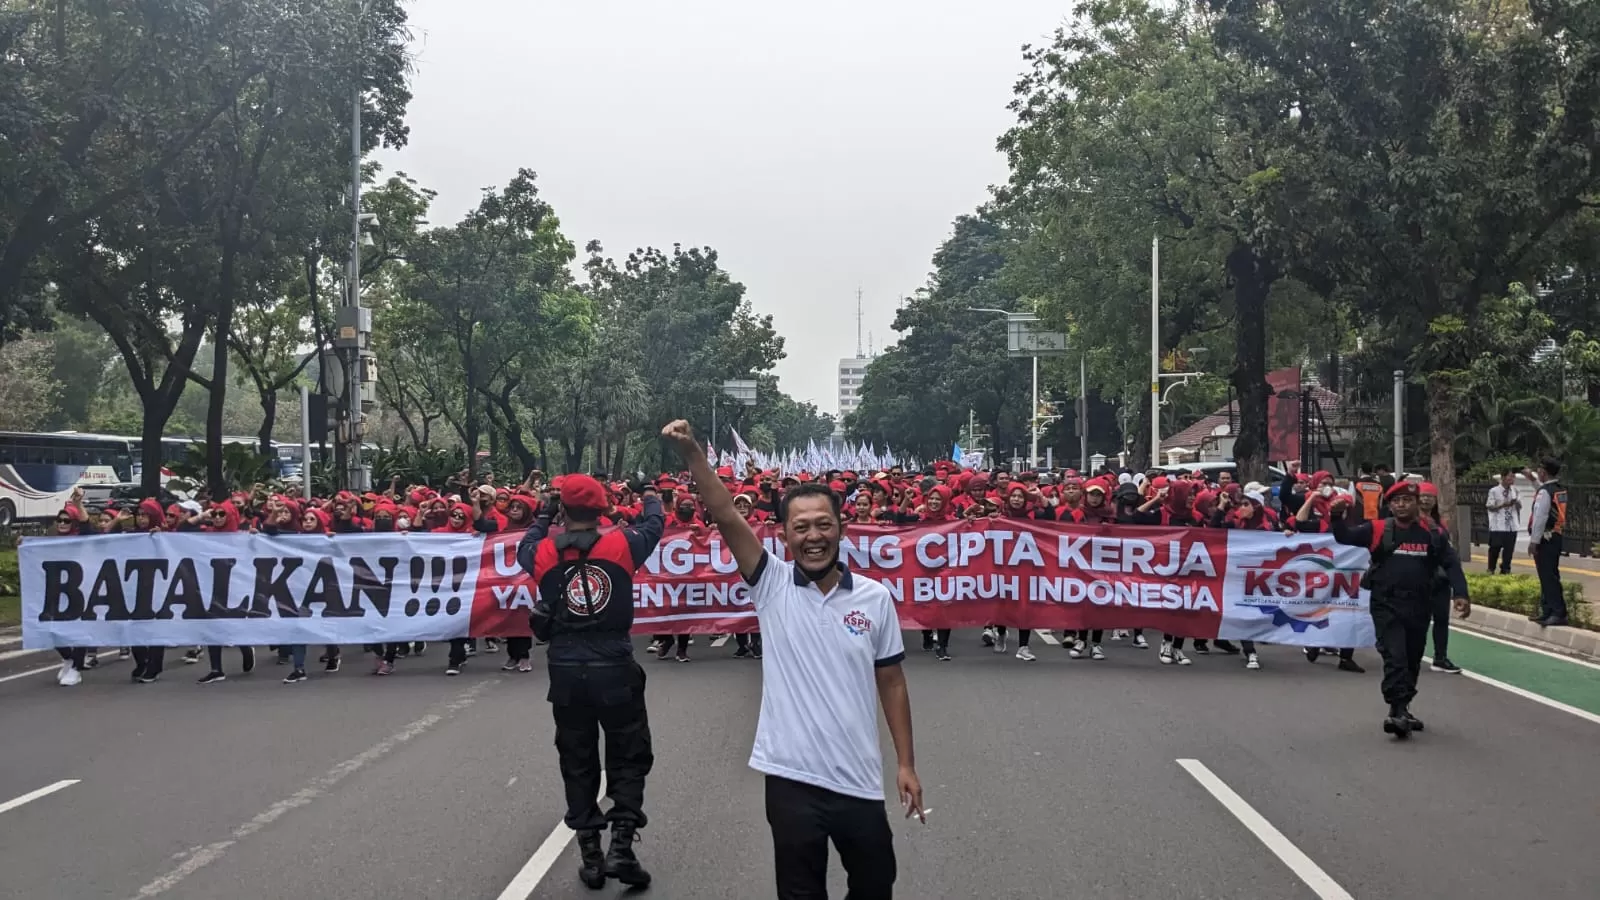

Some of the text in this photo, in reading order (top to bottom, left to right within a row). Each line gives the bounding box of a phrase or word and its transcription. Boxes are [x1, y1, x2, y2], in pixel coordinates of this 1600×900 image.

[915, 530, 1046, 567] CIPTA
[1057, 534, 1217, 578] KERJA
[914, 574, 1019, 604] BURUH
[1029, 575, 1219, 612] INDONESIA
[1243, 570, 1361, 600] KSPN
